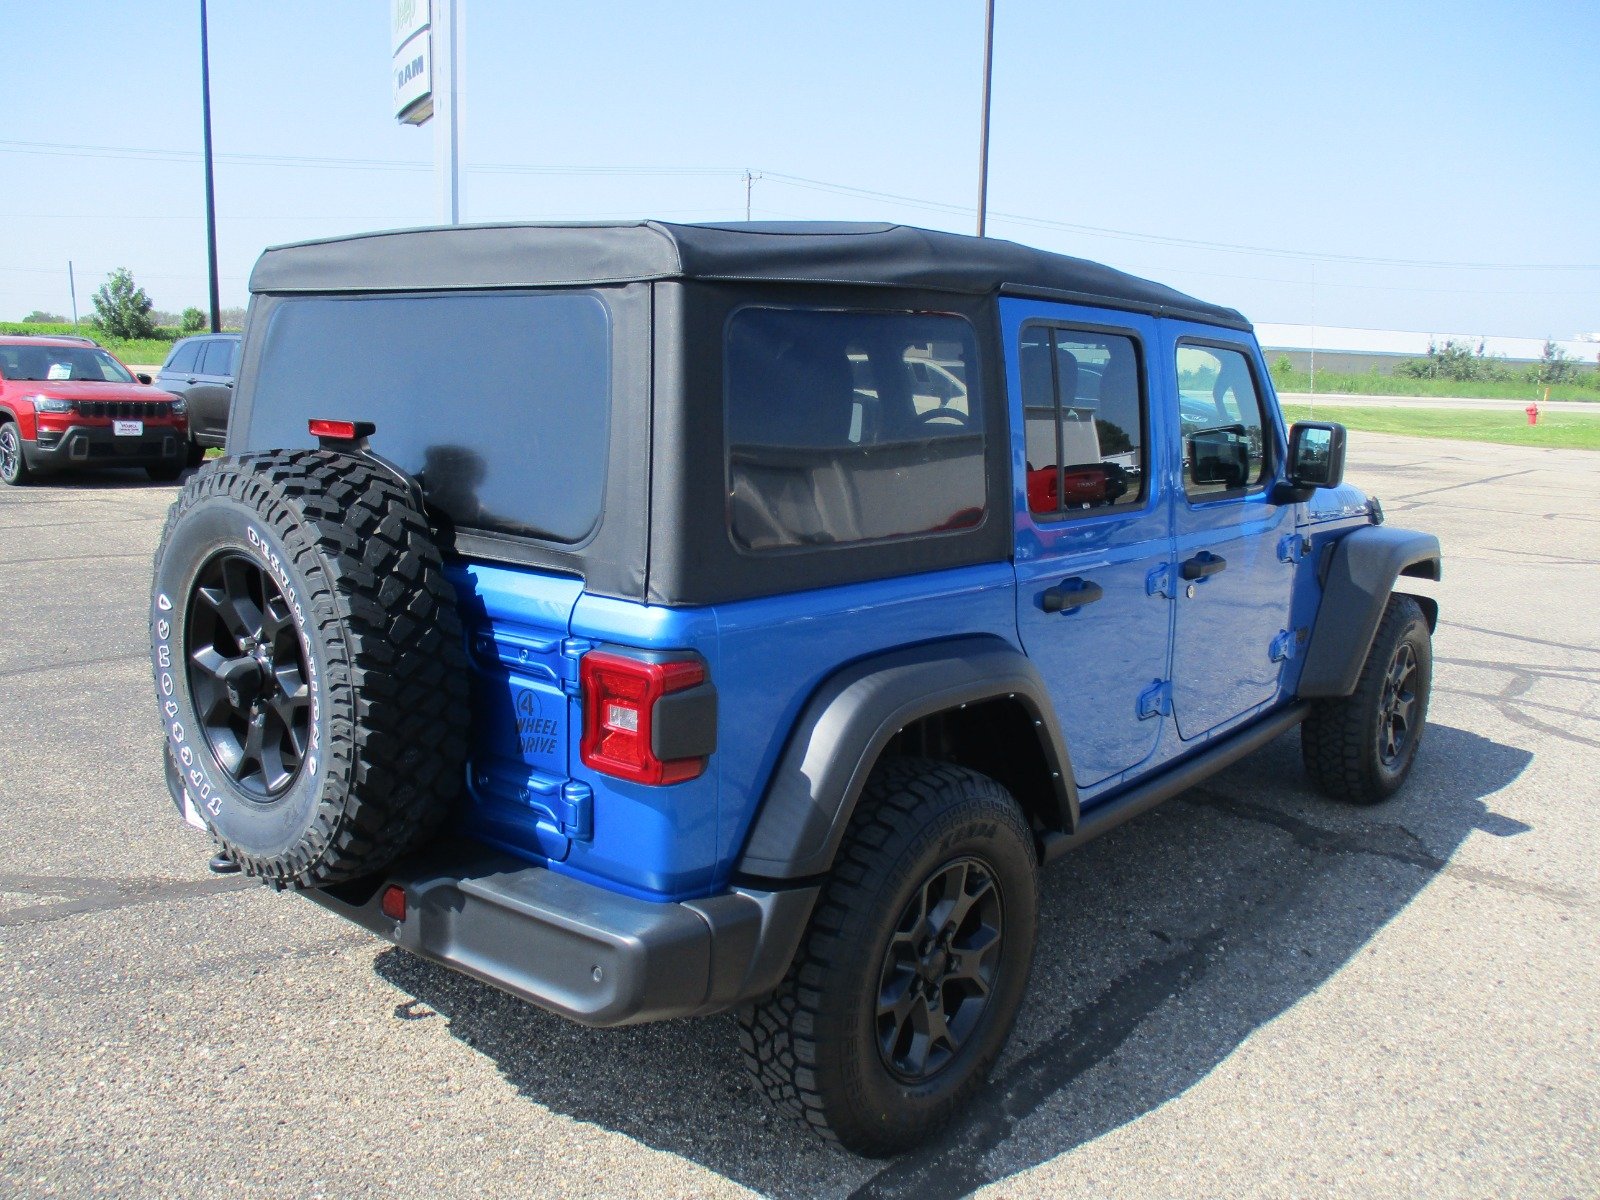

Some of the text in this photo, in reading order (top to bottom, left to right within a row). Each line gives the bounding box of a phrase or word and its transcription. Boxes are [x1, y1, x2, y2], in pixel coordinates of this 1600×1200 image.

[398, 55, 424, 89] RAM
[247, 526, 320, 750] DESTINATION
[520, 693, 534, 717] 4
[515, 717, 558, 736] WHEEL
[516, 736, 558, 755] DRIVE
